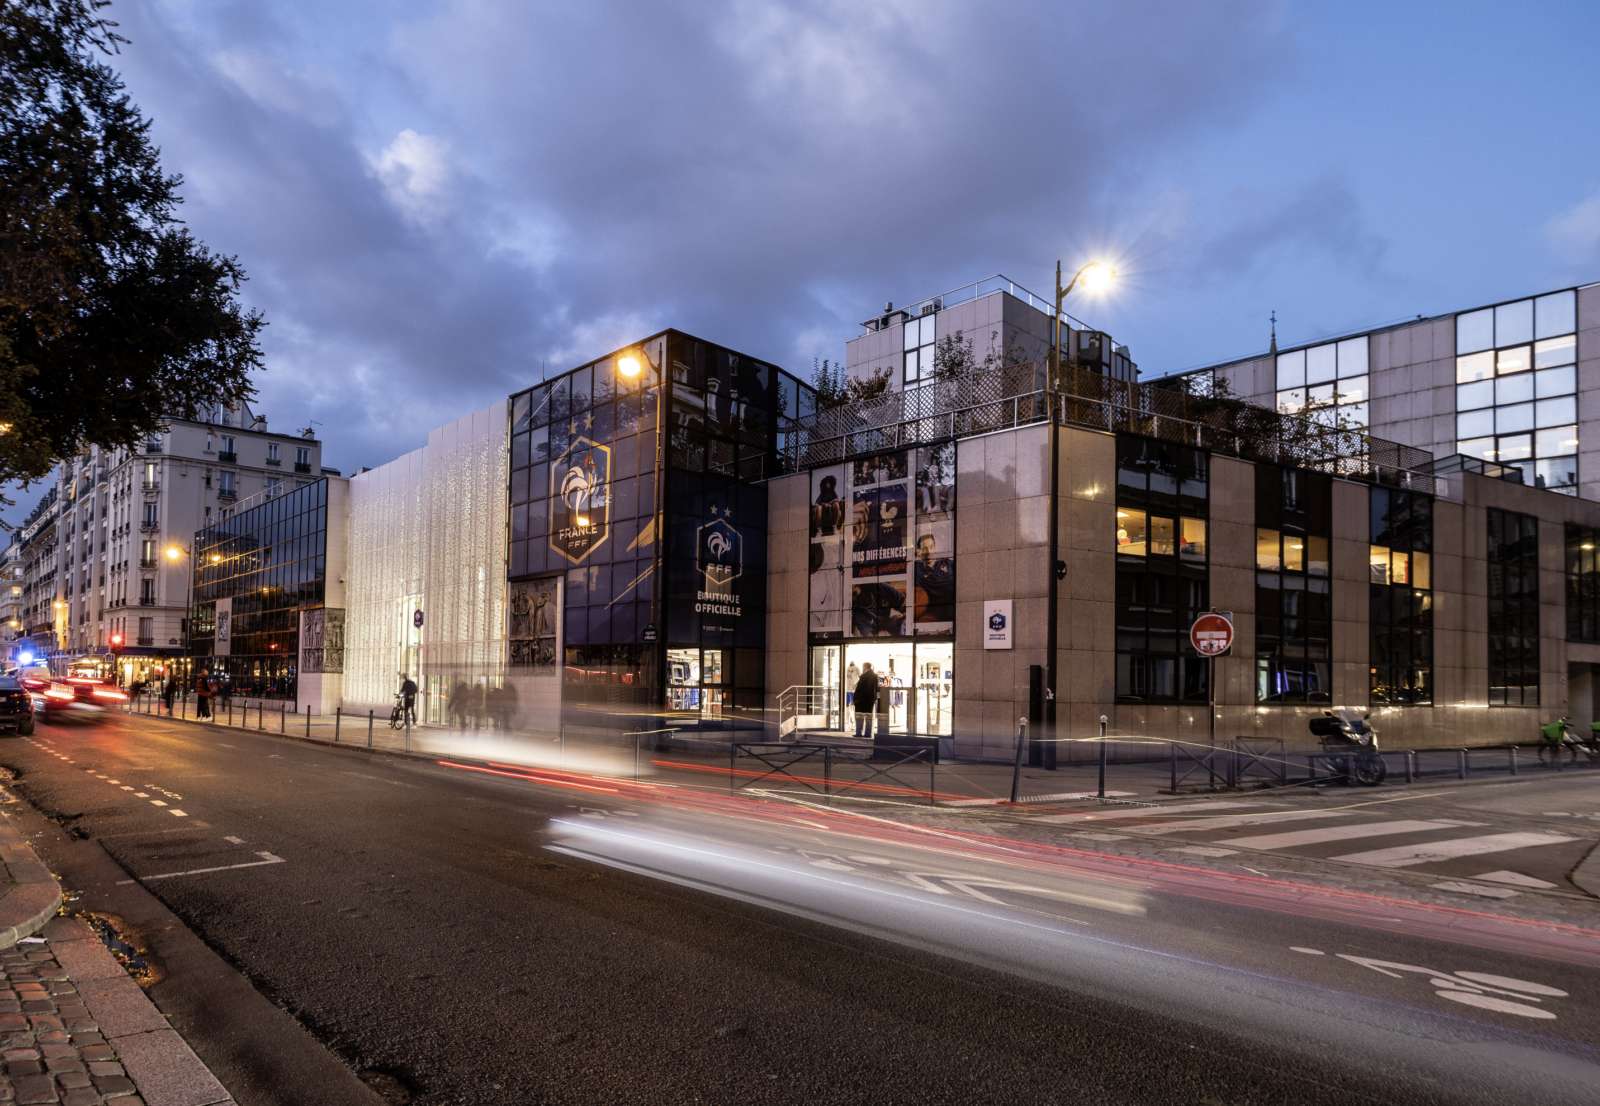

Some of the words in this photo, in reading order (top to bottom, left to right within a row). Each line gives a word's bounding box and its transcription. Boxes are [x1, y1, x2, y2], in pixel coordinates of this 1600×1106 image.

[567, 540, 588, 549] FFF
[707, 563, 732, 574] FFF
[697, 590, 741, 604] BOUTIQUE
[695, 603, 742, 616] OFFICIELLE
